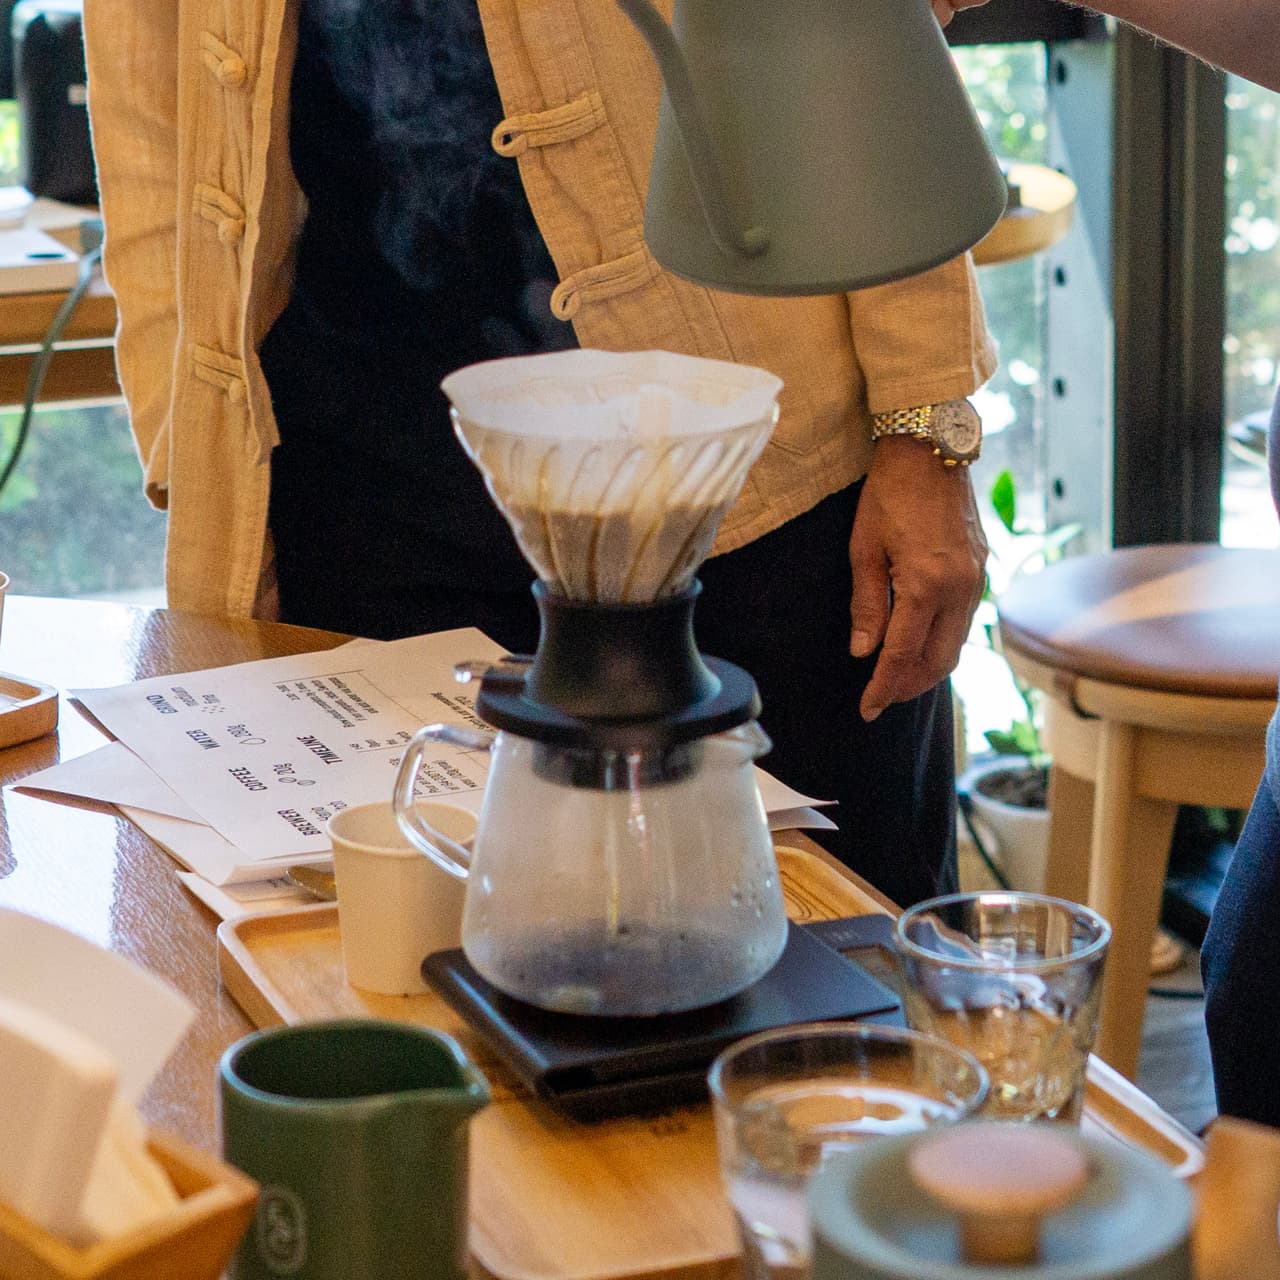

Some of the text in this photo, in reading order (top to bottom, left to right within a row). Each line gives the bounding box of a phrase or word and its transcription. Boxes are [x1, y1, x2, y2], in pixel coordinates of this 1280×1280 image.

[146, 694, 178, 714] GRIND
[186, 728, 221, 750] WATER
[296, 735, 344, 765] TIMELINE
[228, 766, 268, 791] COFFEE
[273, 762, 296, 775] 20g
[277, 808, 322, 836] BREWER
